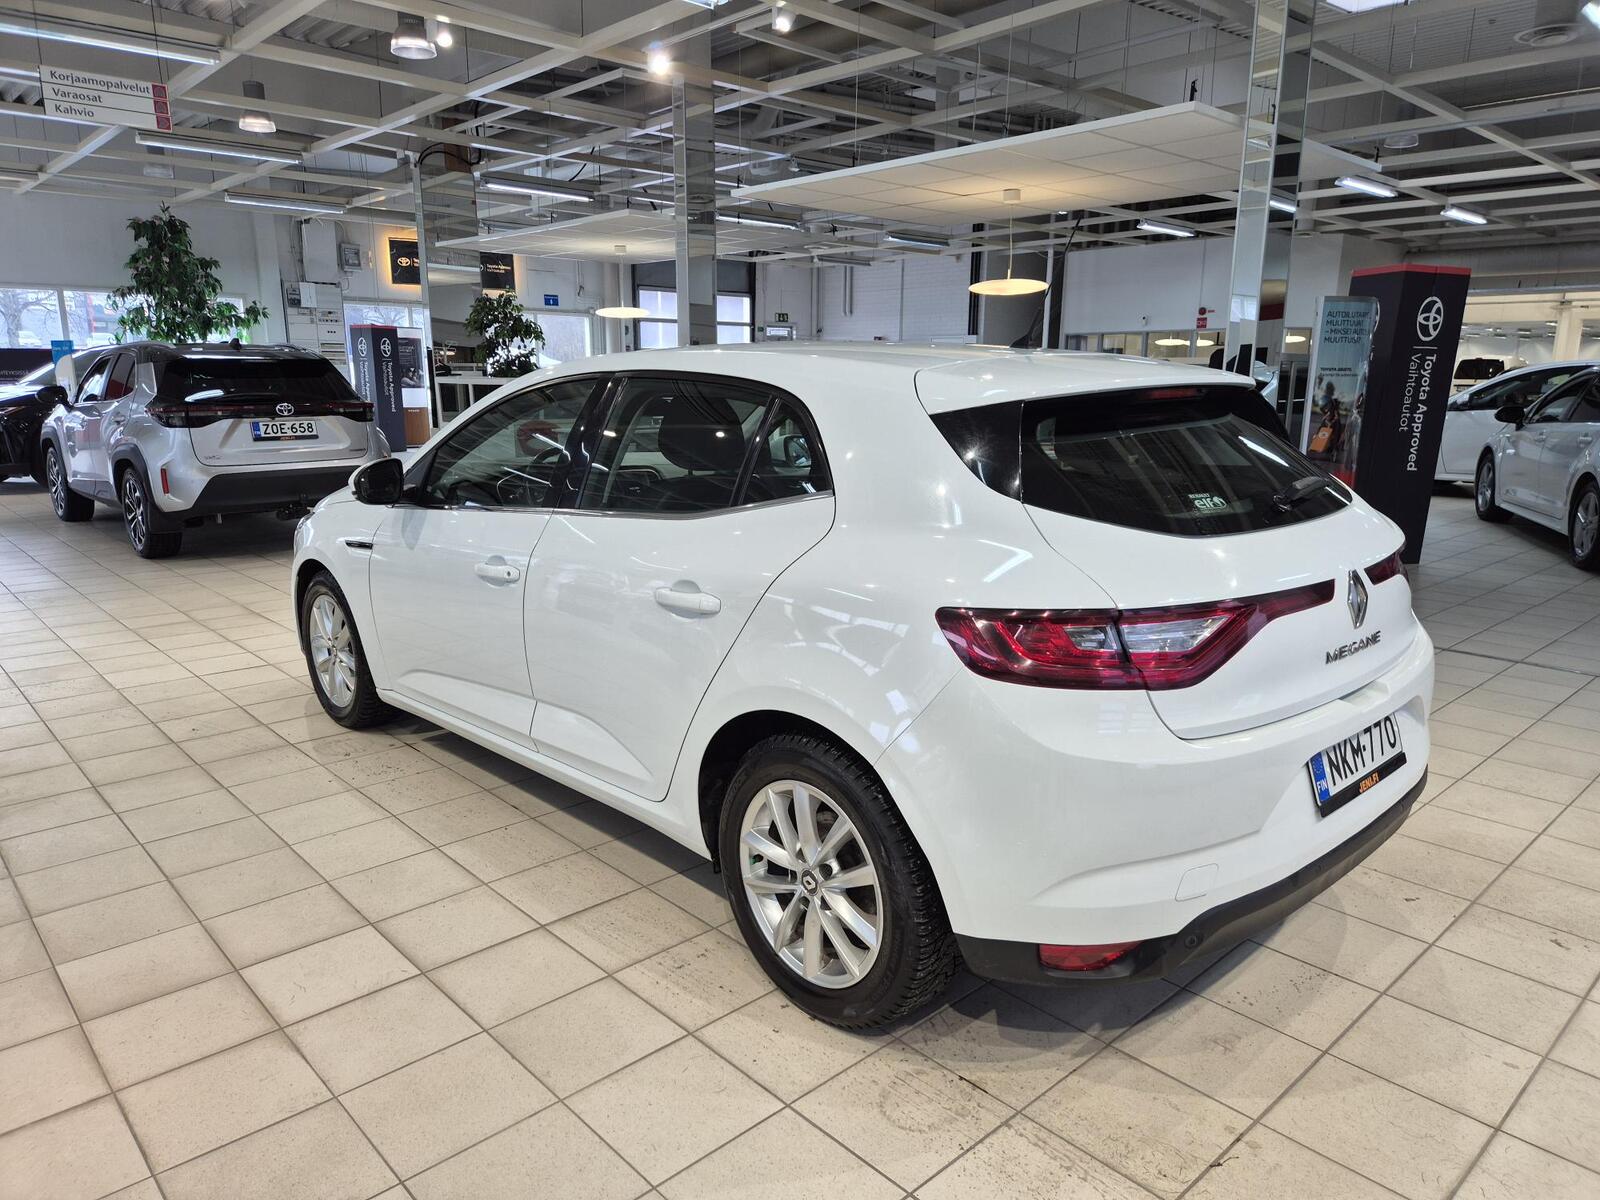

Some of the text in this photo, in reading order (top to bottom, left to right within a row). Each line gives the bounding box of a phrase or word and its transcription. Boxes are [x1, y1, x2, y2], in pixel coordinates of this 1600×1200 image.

[50, 70, 151, 95] Korjaamopalvelut
[52, 87, 103, 104] Varaosat
[55, 103, 95, 118] Kahvio
[389, 382, 397, 412] Approved
[1399, 353, 1422, 432] Vaihtoautot
[1406, 353, 1437, 471] Toyota Approved
[262, 422, 314, 435] ZOE-658
[1194, 498, 1213, 508] elf
[1325, 630, 1381, 665] MEGANE
[1316, 715, 1397, 792] FIN NKM-770
